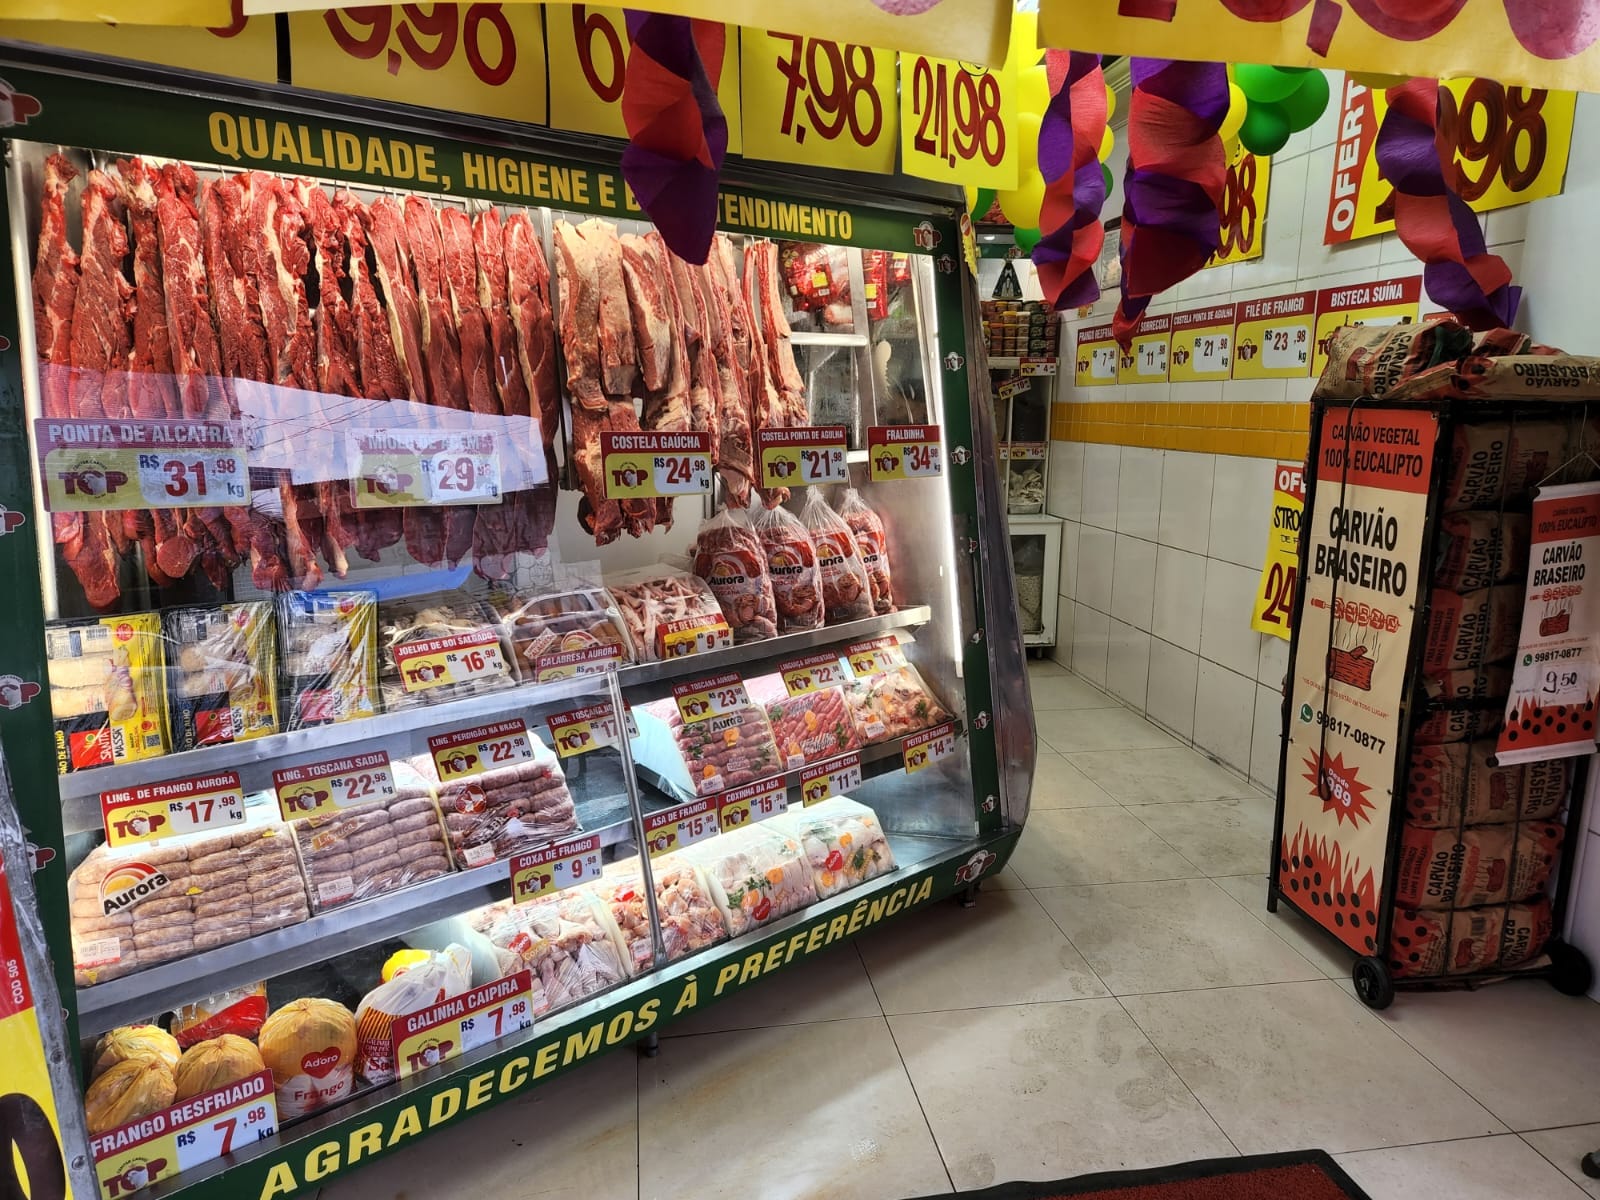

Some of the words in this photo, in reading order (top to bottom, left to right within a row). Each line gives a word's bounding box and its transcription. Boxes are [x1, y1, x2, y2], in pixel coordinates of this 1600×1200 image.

[913, 56, 1006, 168] 21,98
[1332, 79, 1367, 232] OFERT
[208, 111, 452, 191] QUALIDADE,
[463, 152, 590, 205] HIGIENE
[598, 174, 616, 209] E
[716, 192, 853, 240] TENDIMENTO
[1331, 289, 1370, 308] BISTECA
[1372, 281, 1403, 302] SUÍNA
[1245, 299, 1261, 318] FILÉ
[1262, 301, 1273, 316] DE
[1274, 297, 1305, 314] FRANGO
[1173, 314, 1193, 326] COSTELA
[1513, 363, 1588, 378] BRASEIRO
[1525, 377, 1580, 388] CARVÃO
[49, 423, 115, 443] PONTA
[121, 424, 146, 443] DE
[153, 424, 234, 443] ALCATRA
[612, 435, 658, 449] COSTELA
[660, 433, 700, 448] GAÚCHA
[761, 431, 789, 442] COSTELA
[790, 431, 811, 441] PONTA
[811, 431, 819, 440] DE
[821, 430, 844, 439] AGULHA
[886, 429, 925, 440] FRALDINHA
[1373, 426, 1420, 446] VEGETAL
[654, 457, 665, 469] R$
[1354, 450, 1423, 478] EUCALIPTO
[227, 481, 245, 498] kg
[700, 477, 710, 488] kg
[1329, 506, 1398, 551] CARVÃO
[819, 555, 844, 567] urora
[1543, 541, 1583, 565] CARVÃO
[708, 575, 745, 586] Aurora
[1314, 544, 1407, 597] BRASEIRO
[1533, 563, 1586, 587] BRASEIRO
[398, 643, 429, 656] JOELHO
[430, 640, 442, 651] DE
[443, 637, 457, 649] BOI
[458, 631, 493, 645] SALGADO
[1453, 613, 1478, 661] CARVÃO
[541, 653, 586, 668] CALABRESA
[588, 647, 618, 660] AURORA
[1534, 648, 1582, 663] 99817-0877
[550, 715, 570, 725] LING.
[112, 728, 124, 758] MASSA
[452, 728, 488, 743] PERDIGÃO
[488, 726, 498, 736] NA
[500, 721, 522, 733] BRASA
[1317, 710, 1386, 754] 99817-0877
[98, 730, 112, 760] SANTA
[277, 769, 305, 783] LING.
[308, 760, 354, 776] TOSCANA
[355, 753, 385, 768] SADIA
[106, 791, 134, 805] LING.
[137, 787, 151, 799] DE
[153, 781, 194, 797] FRANGO
[196, 775, 235, 791] AURORA
[330, 778, 343, 788] R$
[382, 785, 393, 795] kg
[726, 787, 755, 802] COXINHA
[756, 784, 765, 792] DA
[766, 780, 779, 789] ASA
[1321, 775, 1352, 807] 989
[169, 801, 184, 813] R$
[229, 809, 242, 820] kg
[652, 818, 667, 827] ASA
[668, 812, 678, 821] DE
[679, 801, 707, 818] FRANGO
[520, 855, 543, 867] COXA
[546, 849, 557, 859] DE
[559, 839, 592, 856] FRANGO
[1427, 851, 1449, 896] CARVÃO
[103, 872, 169, 916] Aurora
[7, 959, 17, 980] 505
[14, 982, 24, 1004] COD
[407, 1000, 464, 1033] GALINHA
[467, 979, 518, 1007] CAIPIRA
[460, 1018, 475, 1032] R$
[260, 998, 661, 1200] AGRADECEMOS
[674, 975, 697, 1016] À
[713, 876, 934, 998] PREFERÊNCIA
[294, 1080, 345, 1100] Frango
[90, 1115, 166, 1157] FRANGO
[170, 1077, 265, 1126] RESFRIADO
[177, 1131, 196, 1148] R$
